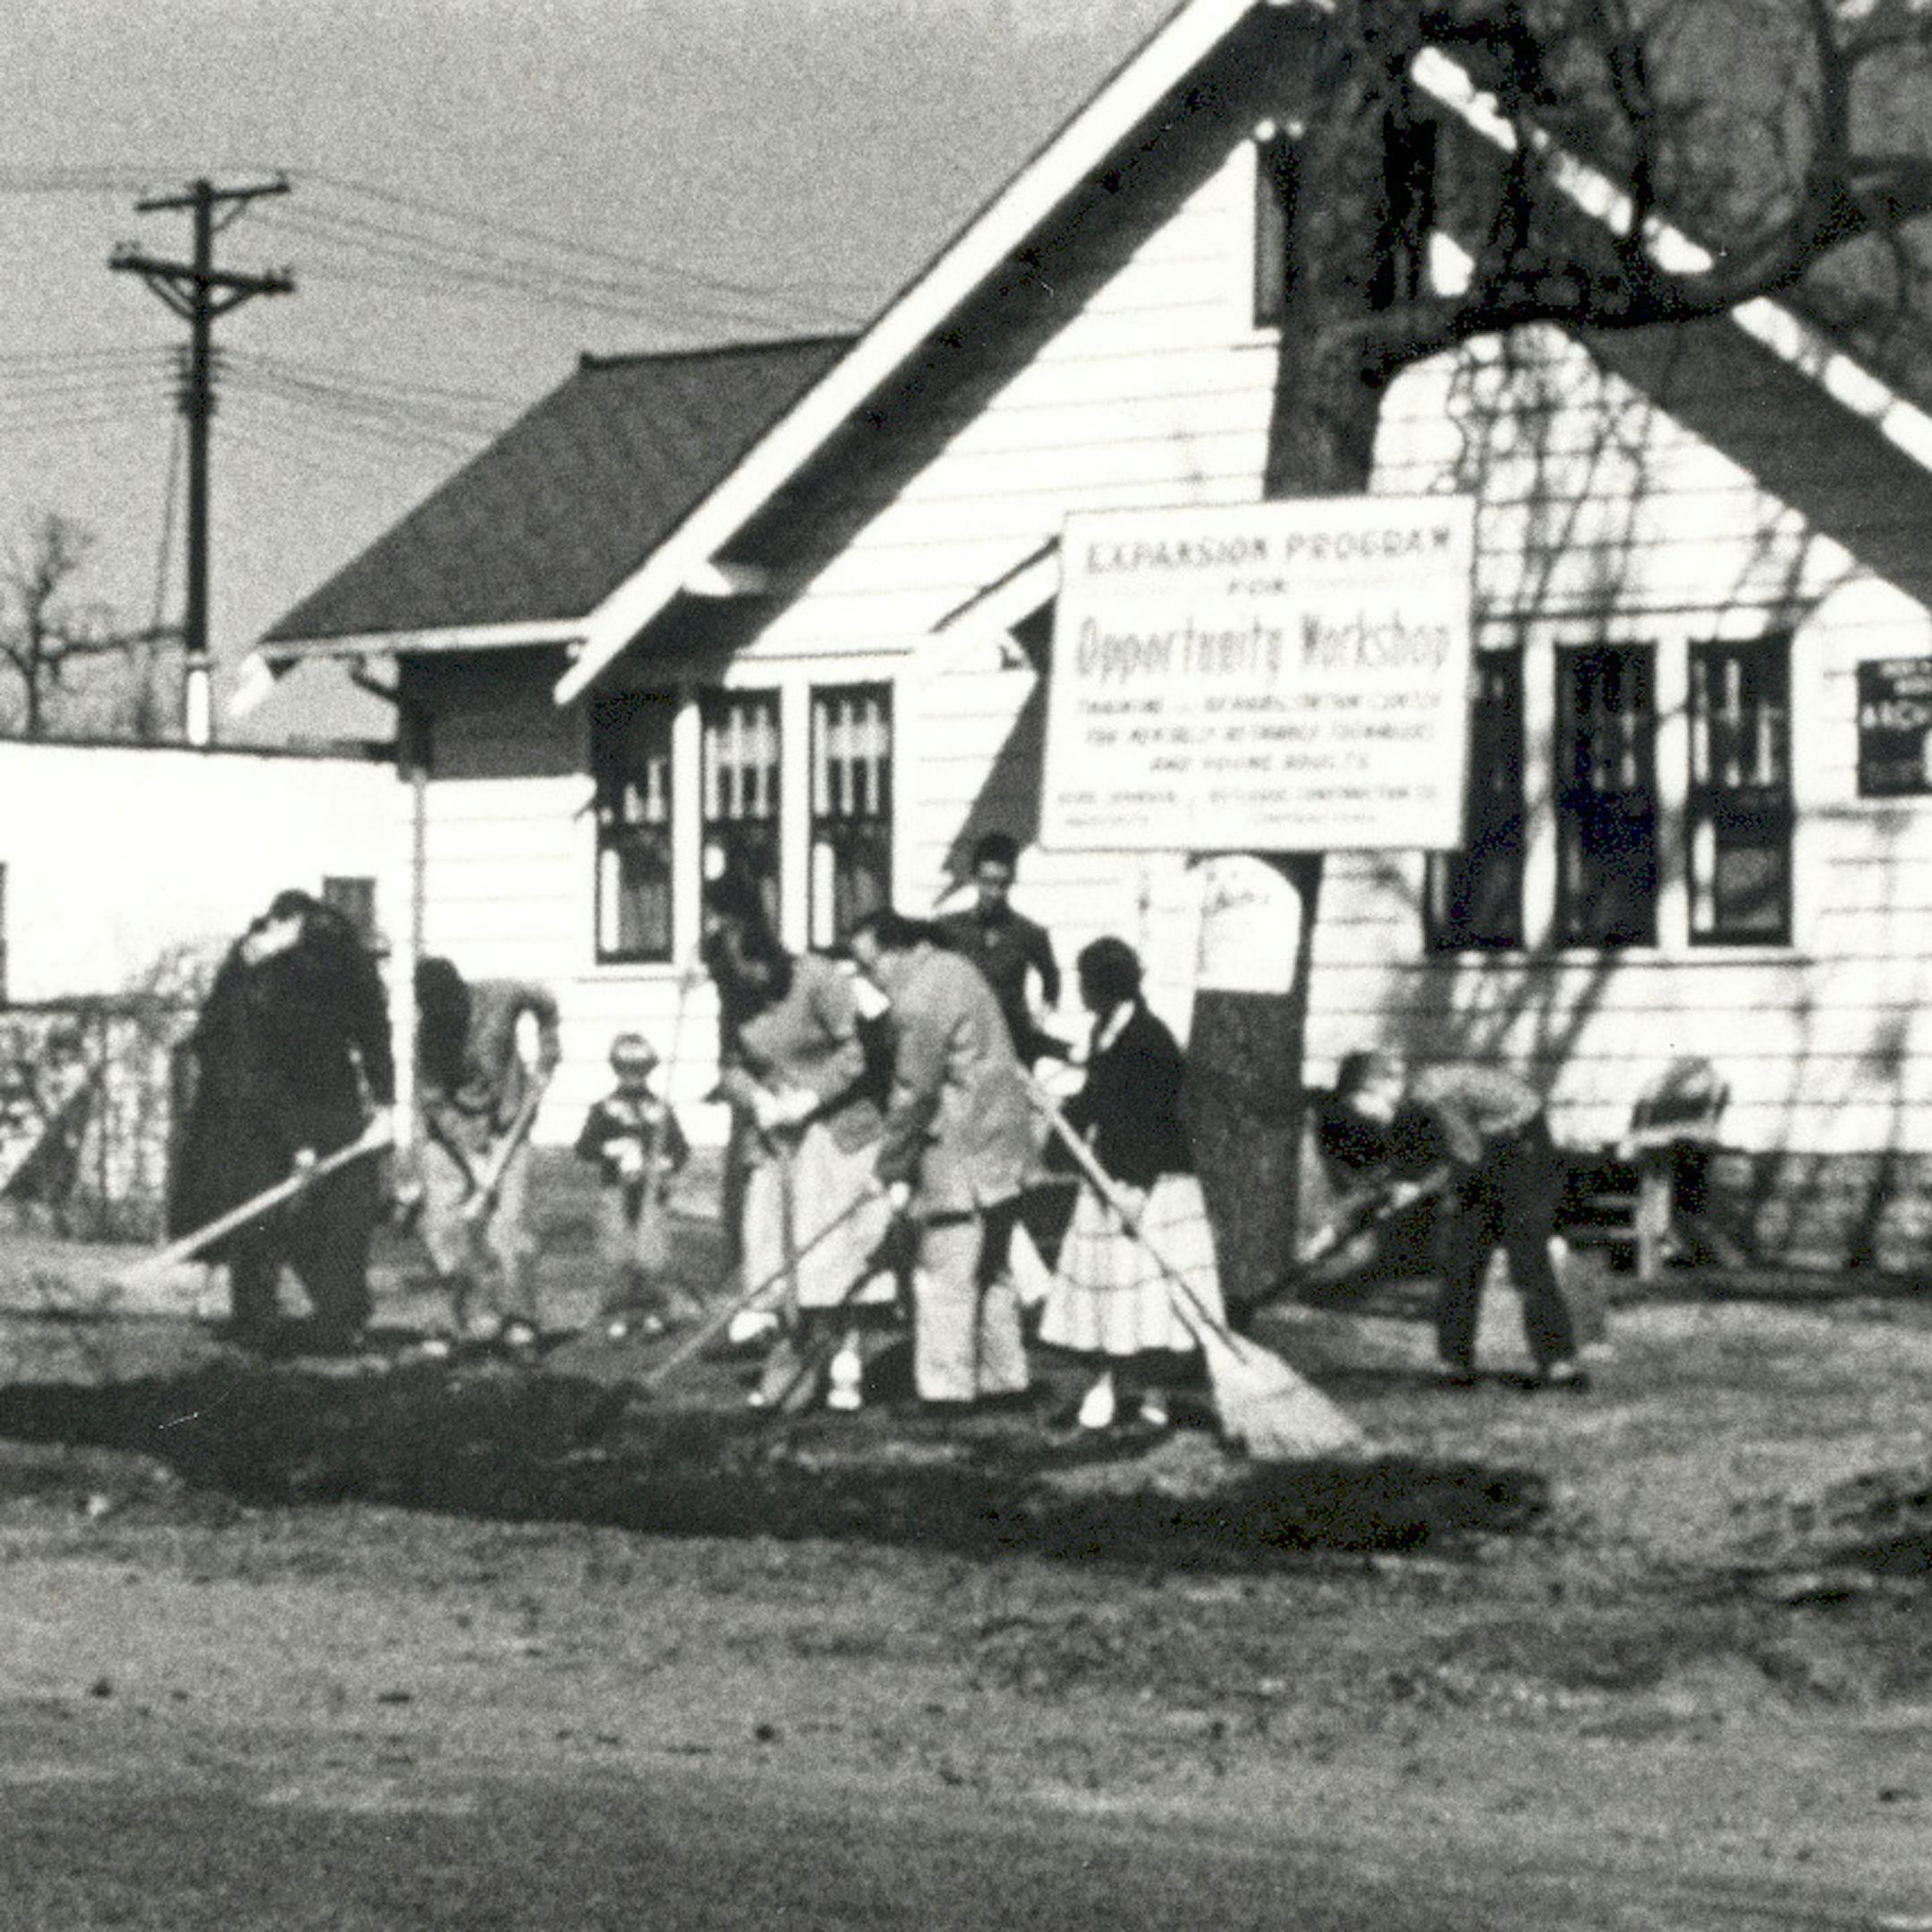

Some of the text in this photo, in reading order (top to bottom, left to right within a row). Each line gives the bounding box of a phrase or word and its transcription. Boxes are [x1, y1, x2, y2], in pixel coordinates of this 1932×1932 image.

[1085, 525, 1452, 575] EXPANSION PROGRAM
[1226, 578, 1288, 597] FOR
[1075, 607, 1452, 690] Opportunity Workshop
